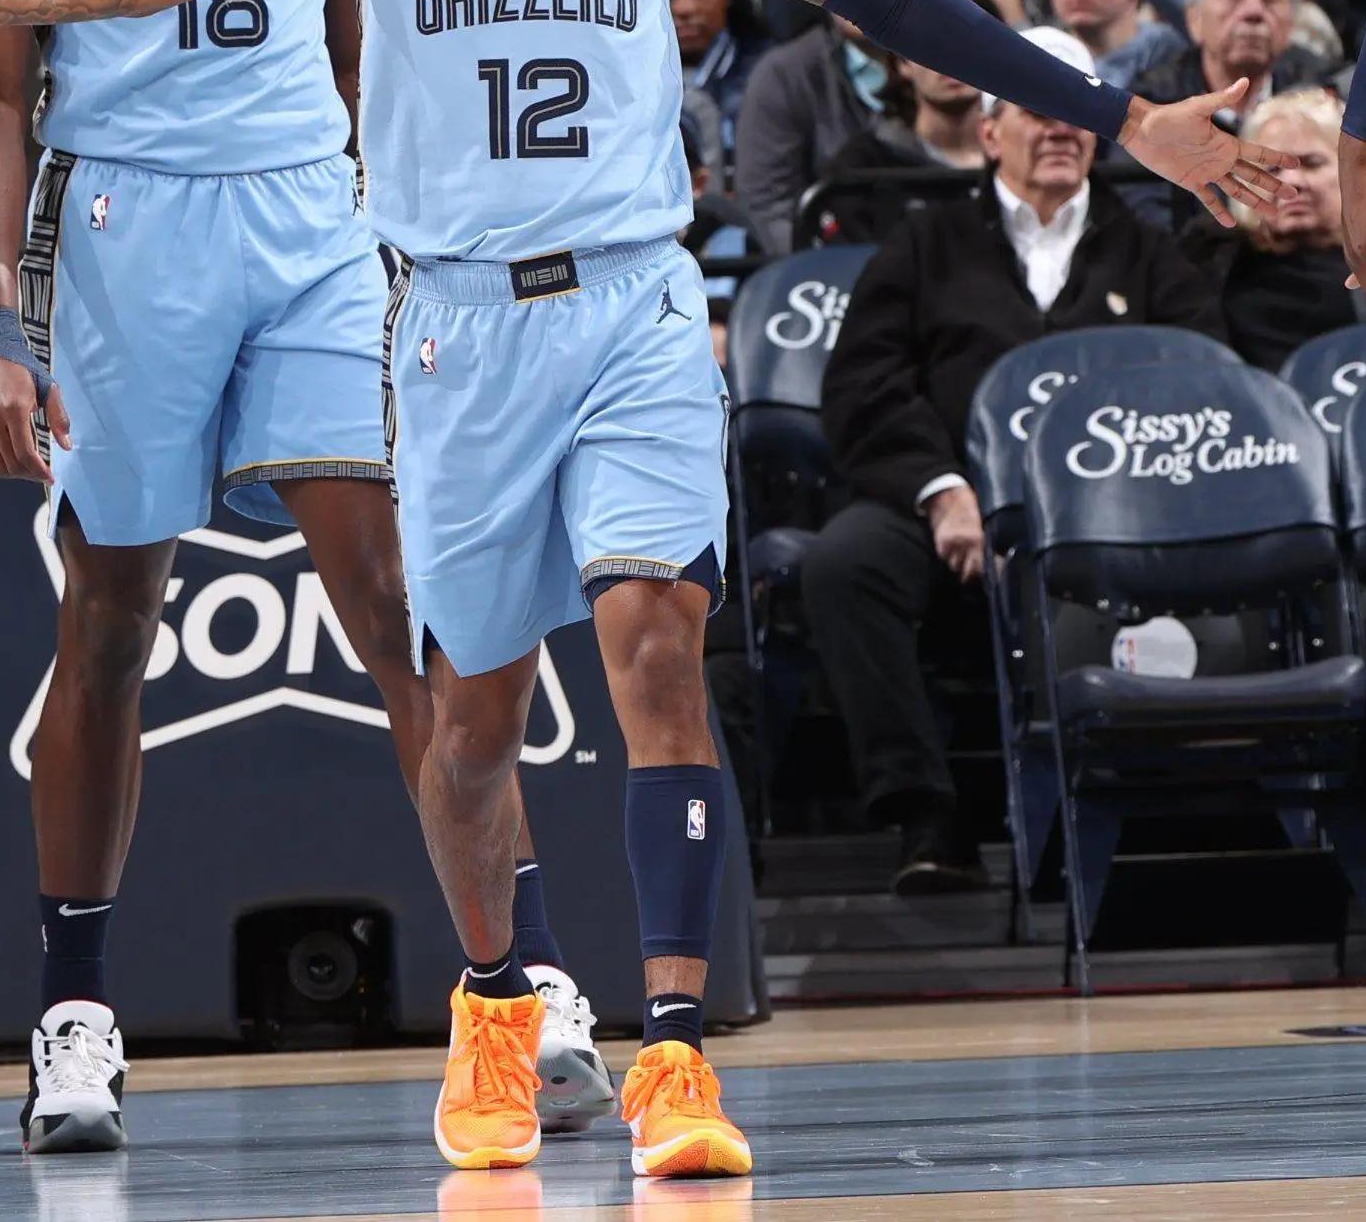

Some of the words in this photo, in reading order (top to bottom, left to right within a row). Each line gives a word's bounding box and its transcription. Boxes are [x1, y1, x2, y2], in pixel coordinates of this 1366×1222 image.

[478, 57, 590, 160] 12
[1065, 405, 1234, 479] Sissy's
[1128, 444, 1195, 486] Log
[1196, 434, 1302, 474] Cabin
